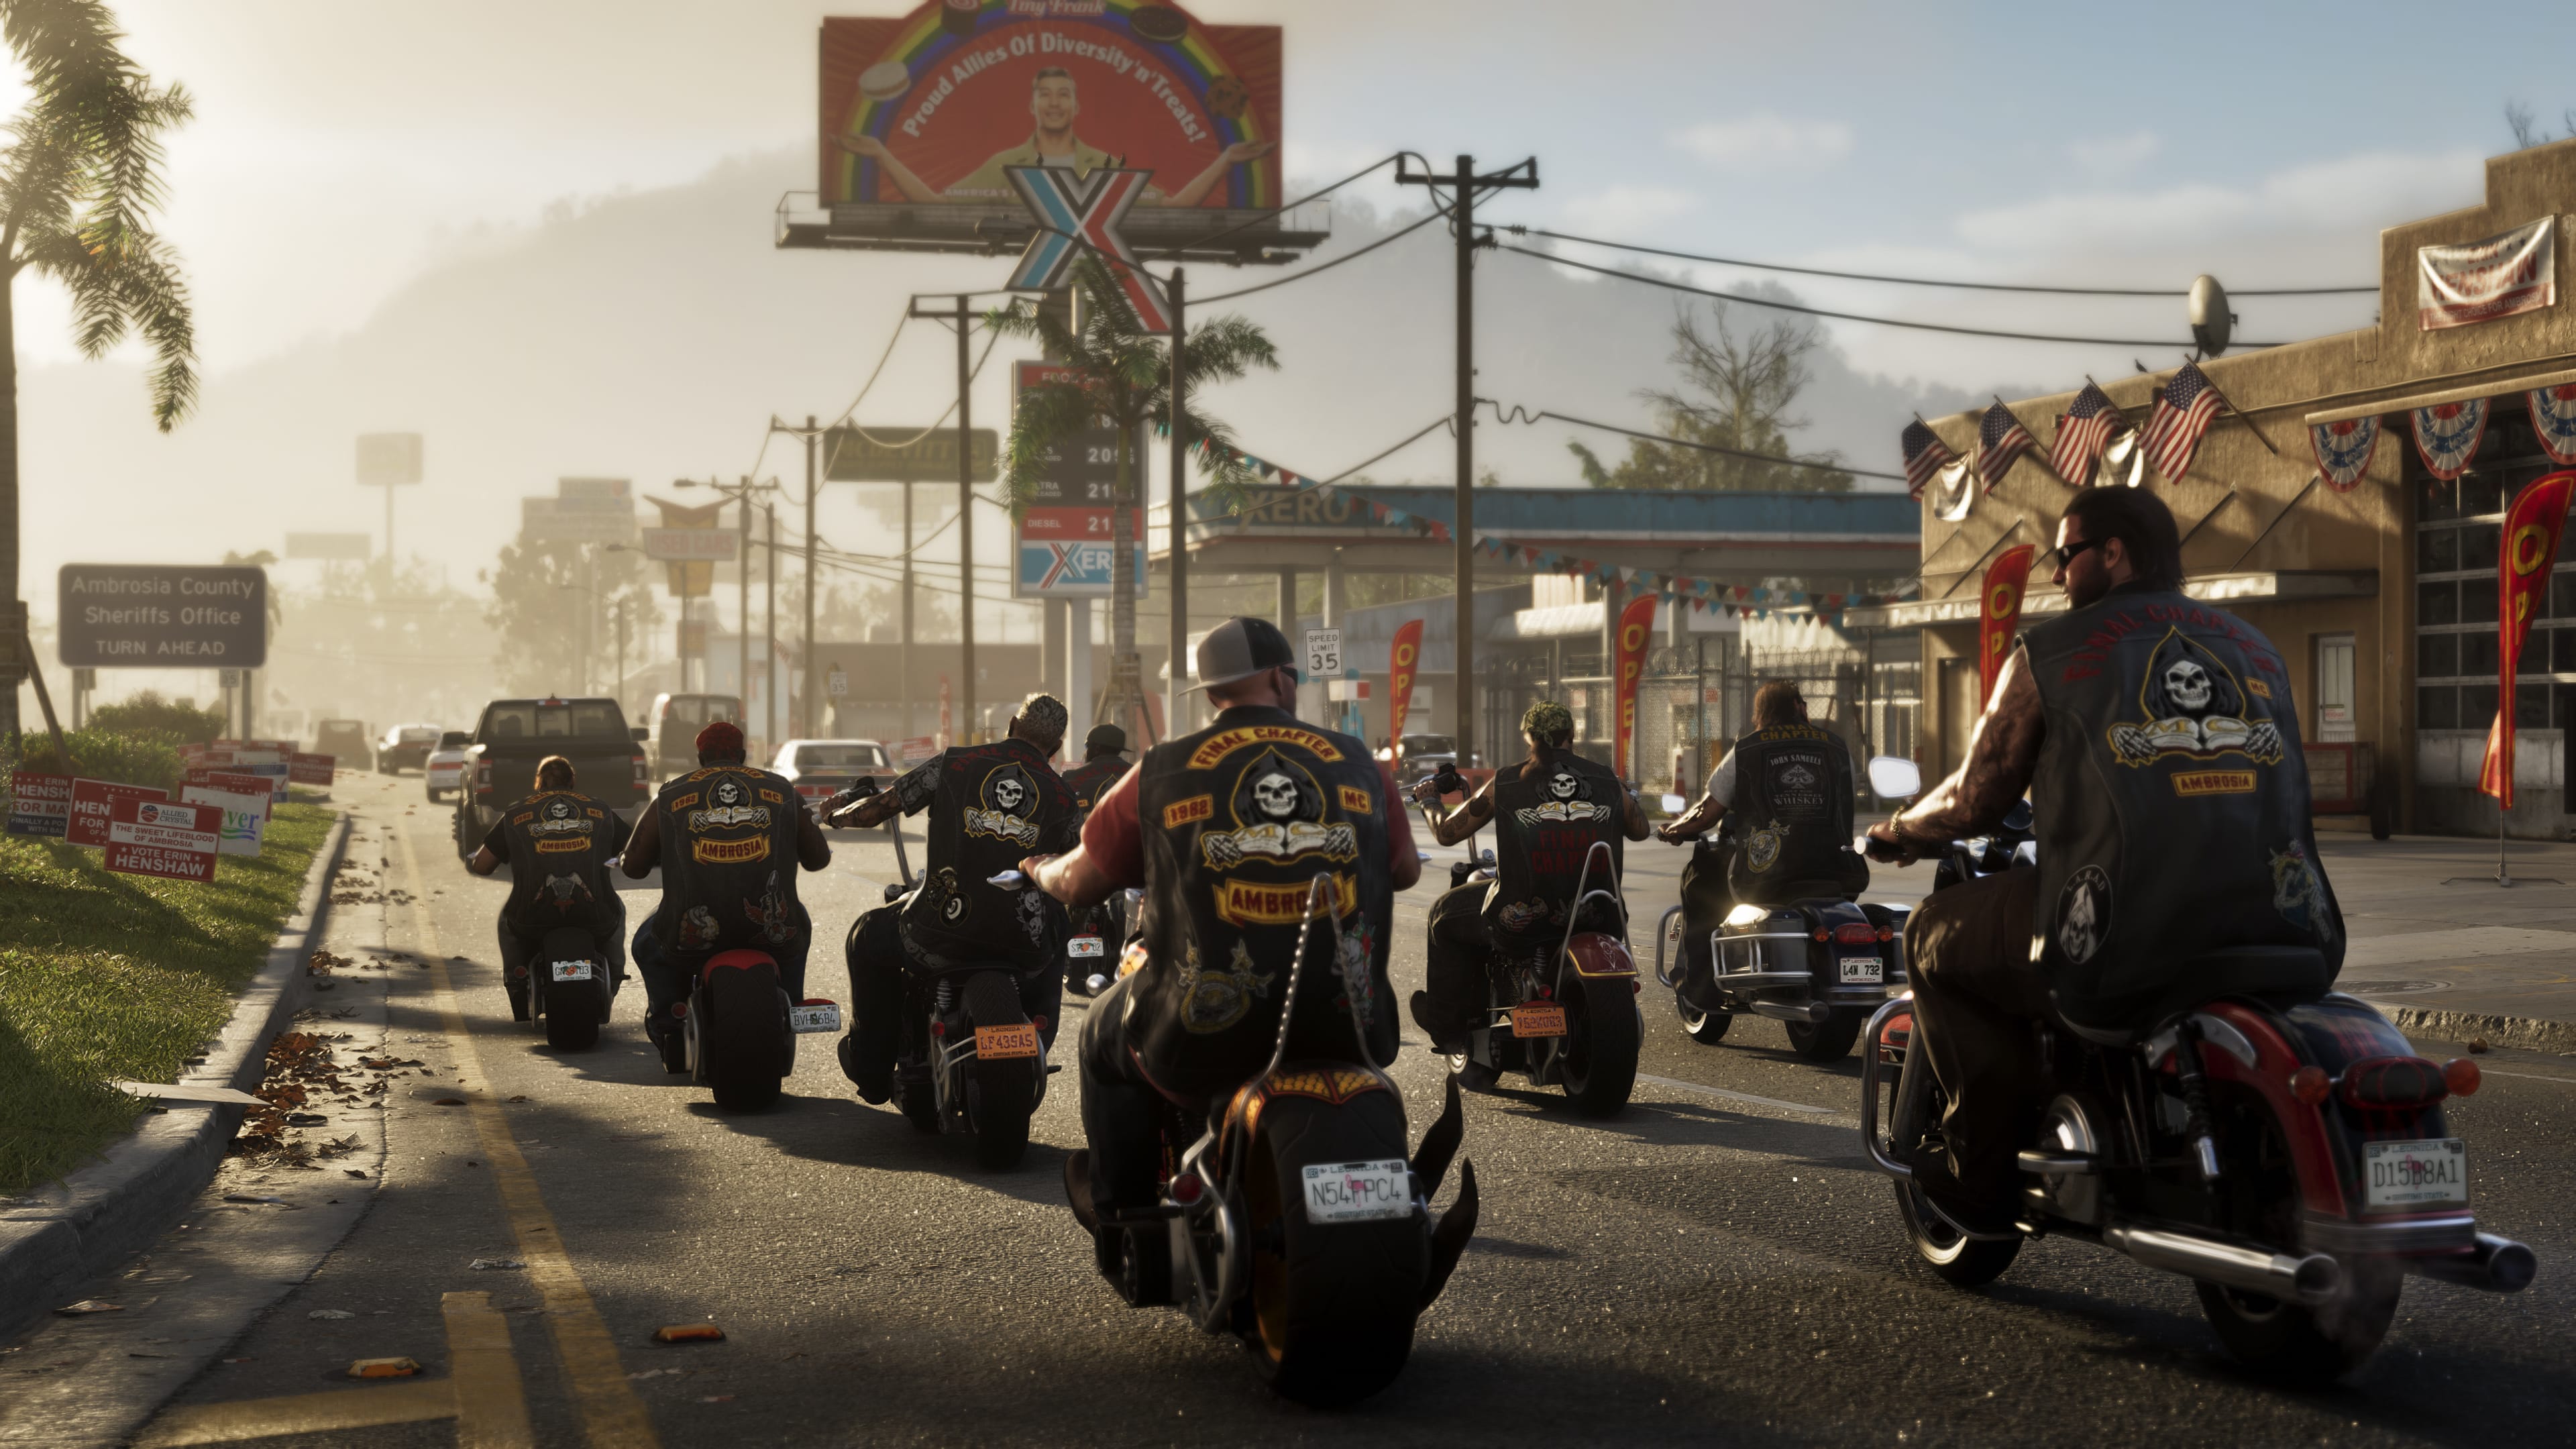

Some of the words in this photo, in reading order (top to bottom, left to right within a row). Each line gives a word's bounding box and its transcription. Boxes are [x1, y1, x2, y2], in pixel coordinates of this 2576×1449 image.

[902, 74, 955, 138] Proud
[951, 46, 1008, 85] Allies
[1010, 33, 1035, 56] Of
[2463, 304, 2487, 318] CHOICE
[2488, 301, 2504, 313] FOR
[1238, 490, 1351, 534] XERO
[1028, 520, 1062, 528] DIESEL
[71, 576, 172, 594] Ambrosia
[179, 577, 254, 599] County
[85, 606, 170, 625] Sheriffs
[180, 606, 241, 625] Office
[1309, 634, 1338, 643] SPEED
[2061, 611, 2144, 684] FINAL
[2145, 603, 2276, 674] CHAPTER
[96, 641, 147, 655] TURN
[157, 641, 225, 655] AHEAD
[1311, 653, 1338, 671] 35
[830, 683, 846, 692] 35
[2251, 681, 2267, 694] MC
[1760, 729, 1829, 741] CHAPTER
[1195, 729, 1249, 767] FINAL
[1253, 727, 1336, 759] CHAPTER
[1770, 755, 1788, 766] JOHN
[1790, 754, 1822, 766] SAMUELS
[45, 777, 67, 786] ERIN
[2180, 774, 2251, 791] AMBROSIA
[763, 790, 780, 801] MC
[1773, 797, 1825, 806] WHISKEY
[13, 800, 41, 814] FOR
[45, 803, 70, 816] MA
[1171, 798, 1209, 821] 1982
[1343, 790, 1367, 810] MC
[159, 815, 193, 826] CRYSTAL
[160, 809, 189, 818] ALLIED
[11, 817, 42, 826] FINALLY
[79, 816, 105, 828] FOR
[115, 824, 133, 833] THE
[135, 826, 164, 837] SWEET
[167, 829, 215, 843] LIFEBLOOD
[1540, 827, 1597, 849] FINAL
[148, 836, 193, 848] AMBROSIA
[541, 839, 586, 850] AMBROSIA
[702, 839, 763, 858] AMBROSIA
[131, 846, 162, 858] VOTE
[164, 850, 191, 861] ERIN
[115, 853, 206, 876] HENSHAW
[2391, 1142, 2440, 1153] LEONIDA
